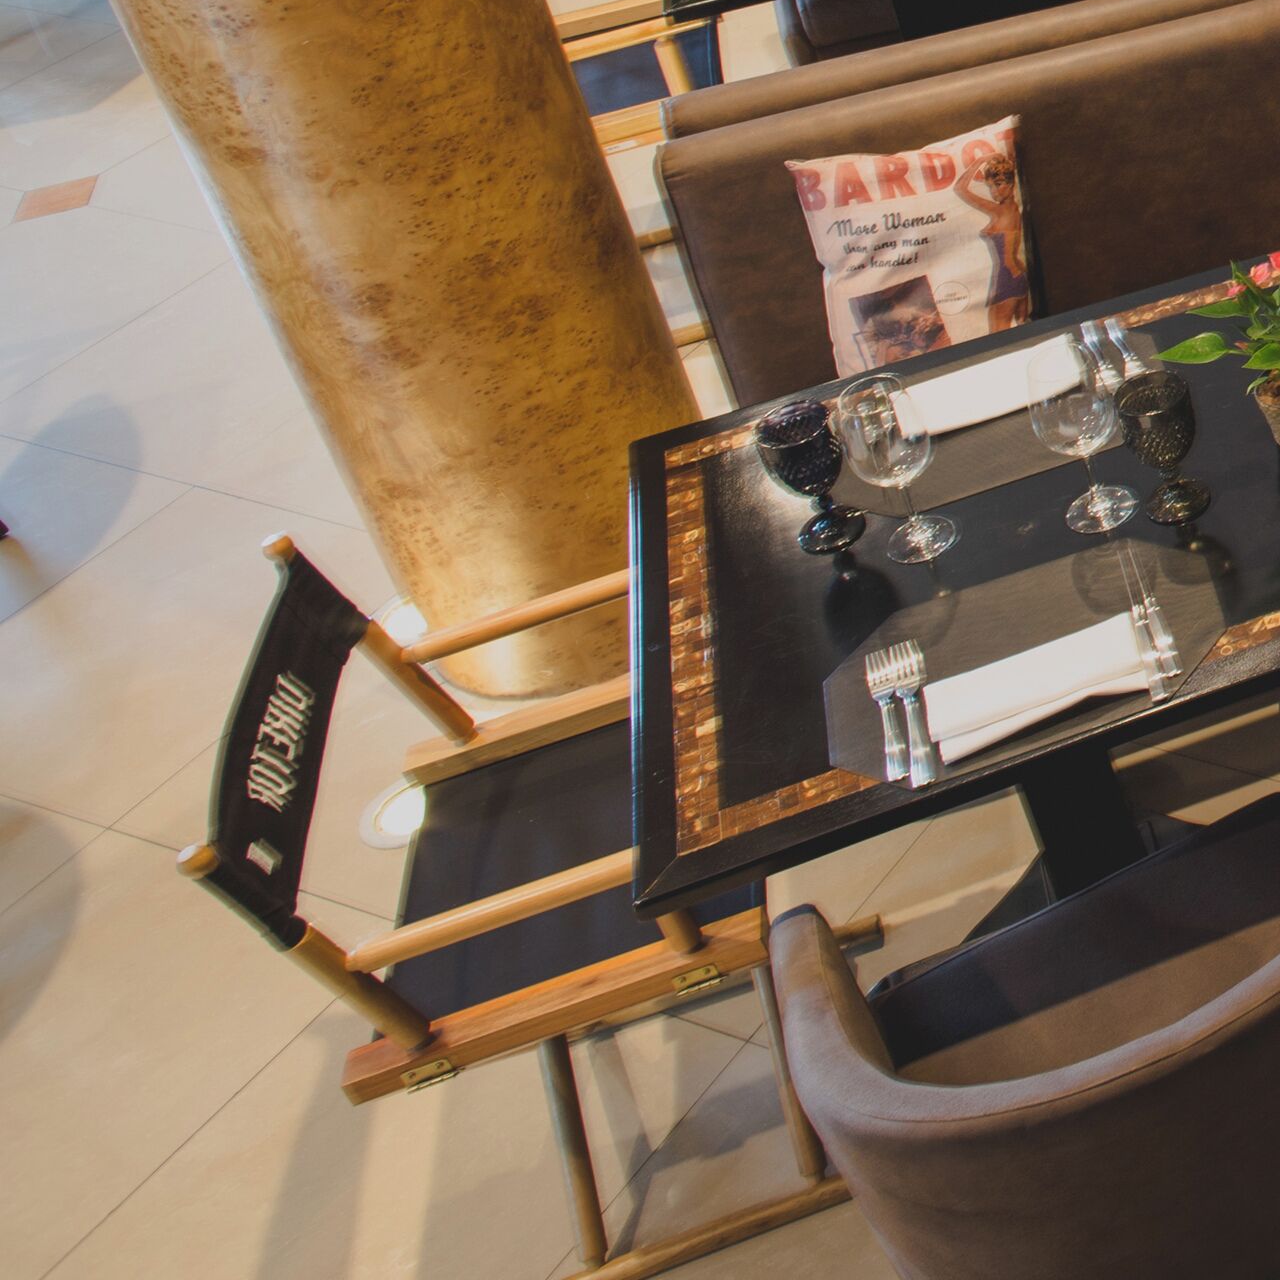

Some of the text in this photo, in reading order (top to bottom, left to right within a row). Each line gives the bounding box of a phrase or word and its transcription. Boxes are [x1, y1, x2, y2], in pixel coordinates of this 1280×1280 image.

[795, 127, 1017, 212] BARDOT
[826, 212, 947, 237] More Woman
[870, 239, 897, 252] any
[901, 236, 930, 247] man
